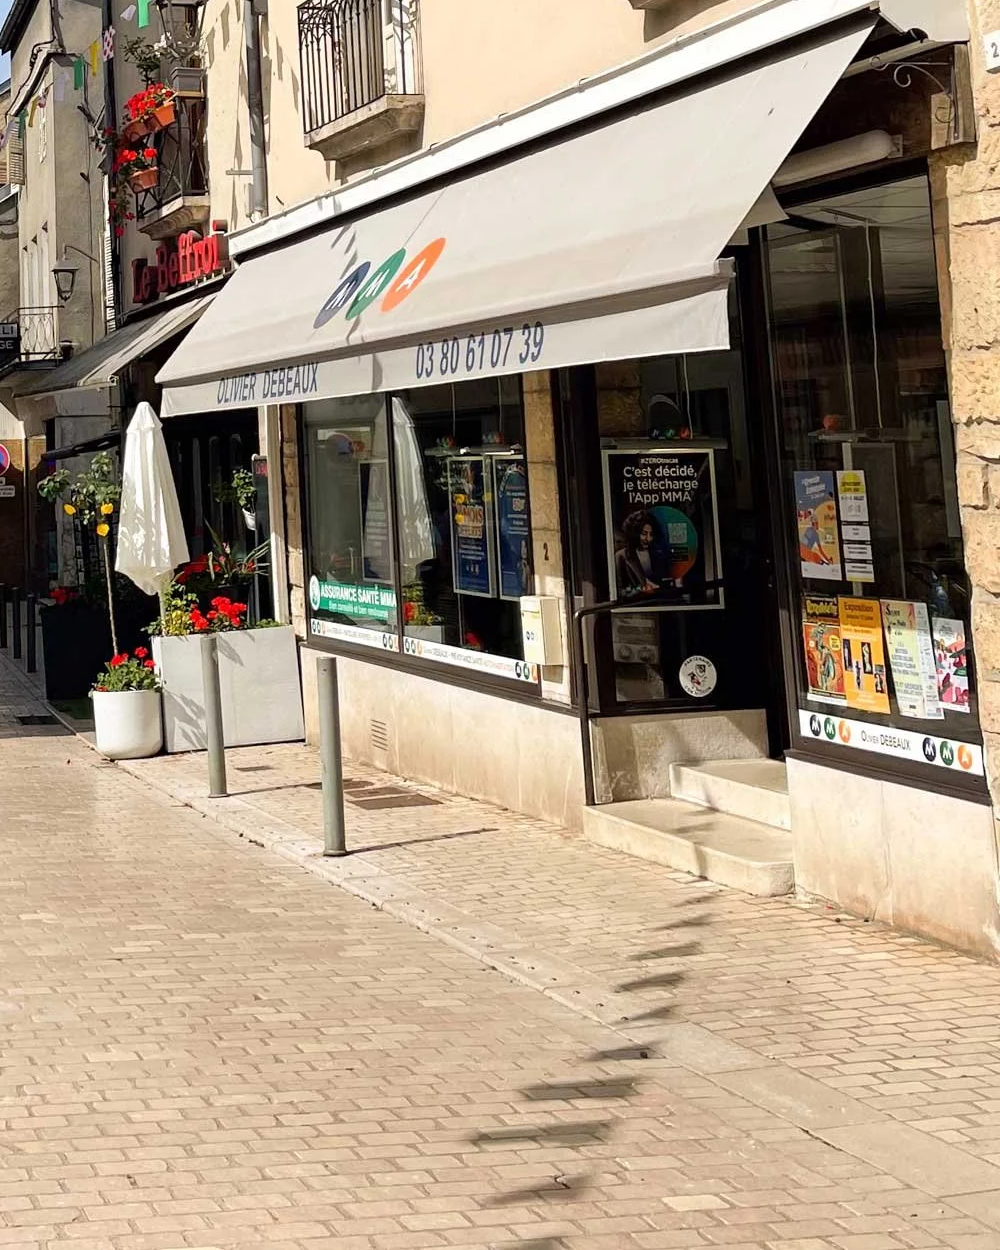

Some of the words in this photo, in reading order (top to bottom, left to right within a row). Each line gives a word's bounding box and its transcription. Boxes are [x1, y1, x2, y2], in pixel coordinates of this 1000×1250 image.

[416, 342, 434, 380] 03
[440, 336, 460, 376] 80
[465, 331, 486, 372] 61
[490, 326, 514, 369] 07
[519, 320, 544, 364] 39
[216, 372, 257, 405] OLIVIER
[262, 361, 319, 399] DEBEAUX
[623, 466, 652, 478] C'est
[654, 464, 698, 478] décidé,
[623, 479, 634, 492] je
[637, 478, 699, 491] télécharge
[661, 491, 692, 503] MMA
[542, 541, 550, 561] 2
[321, 584, 357, 602] ASSURANCE
[357, 583, 380, 605] SANTÉ
[880, 733, 912, 751] DEBEAUX
